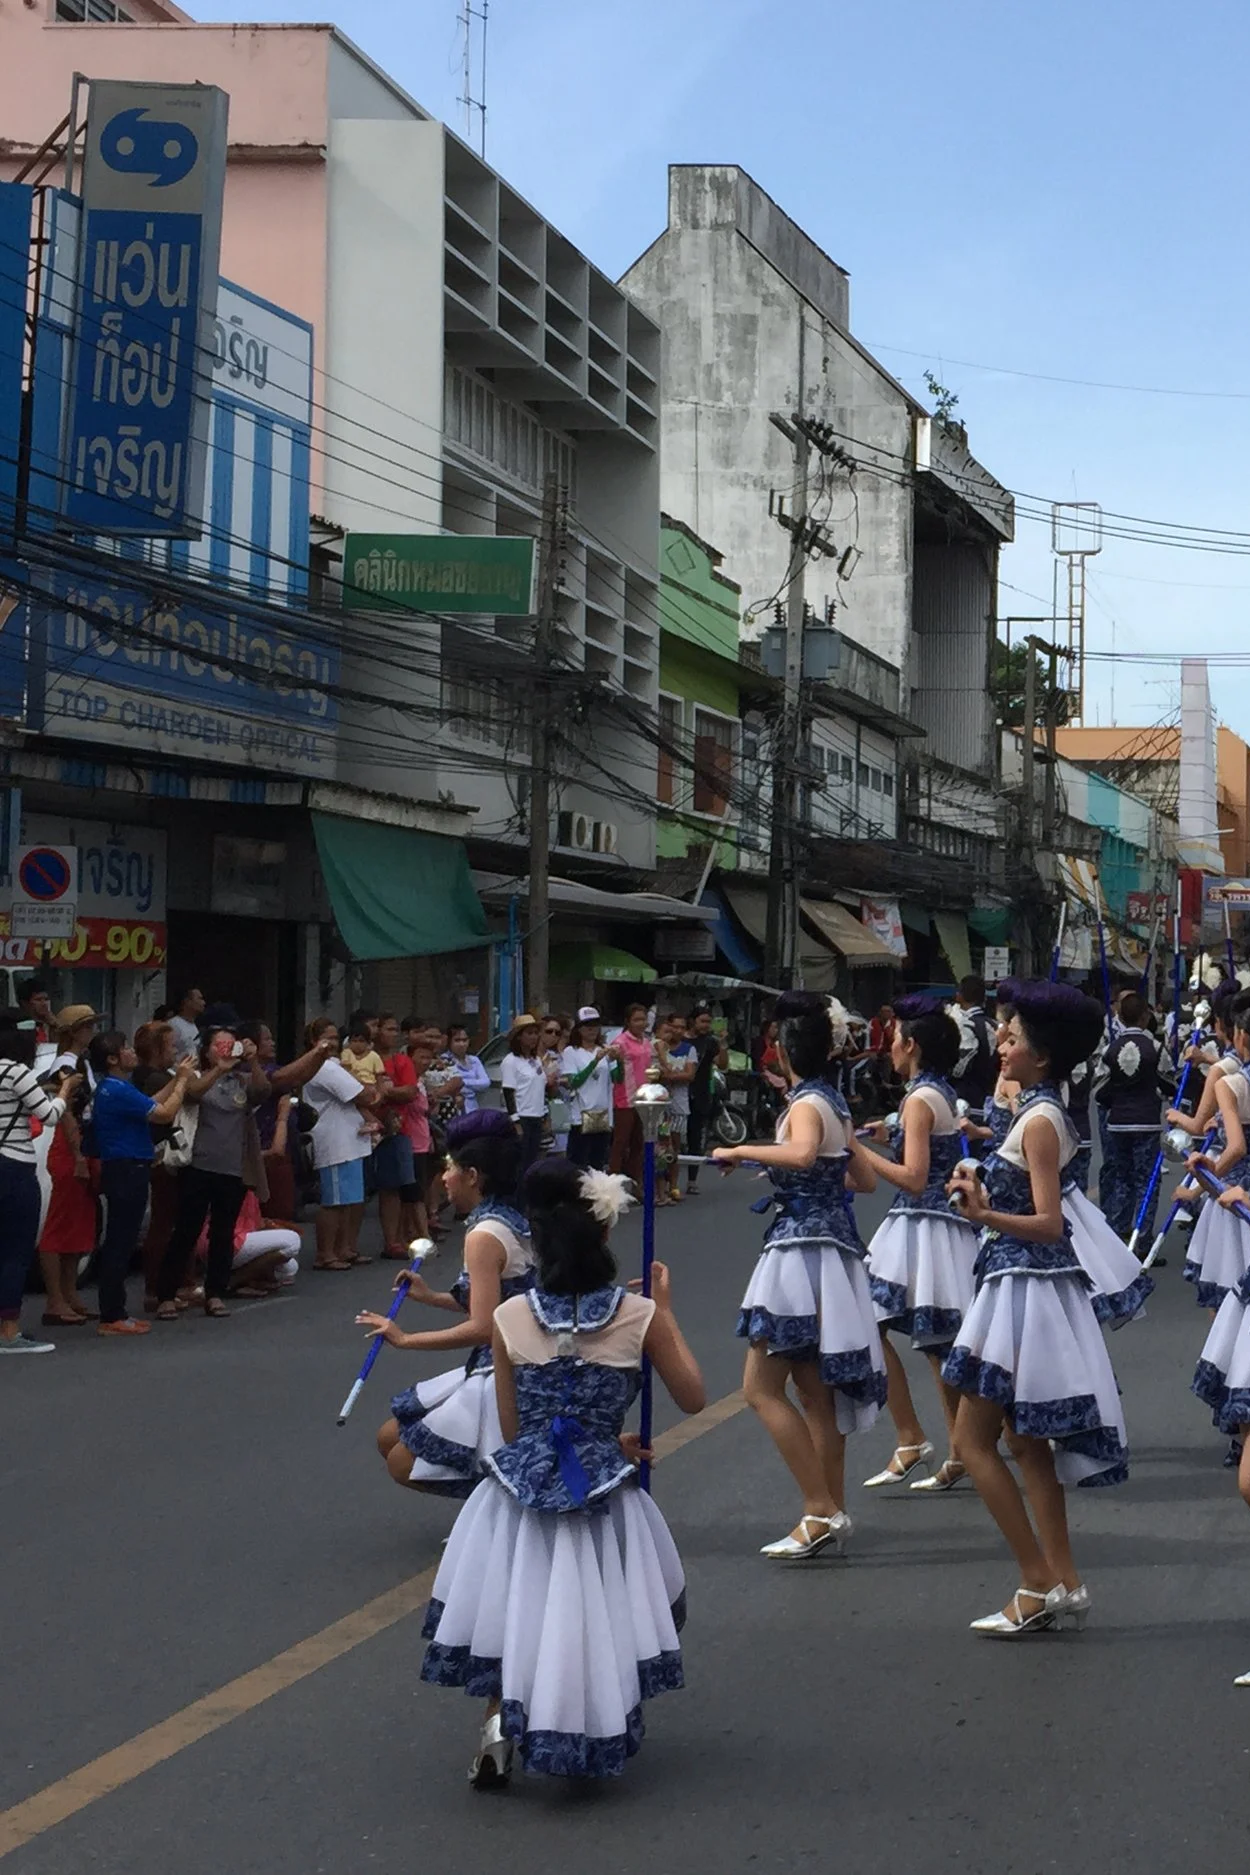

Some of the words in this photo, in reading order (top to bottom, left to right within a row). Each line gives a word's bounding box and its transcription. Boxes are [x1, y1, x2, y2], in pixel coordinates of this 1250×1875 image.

[93, 221, 191, 308] แว่น
[92, 311, 181, 409] ท็อป
[75, 425, 182, 517] เจริญ
[59, 688, 108, 720] TOP
[120, 699, 231, 746] CHAROEN
[240, 723, 321, 763] OPTICAL
